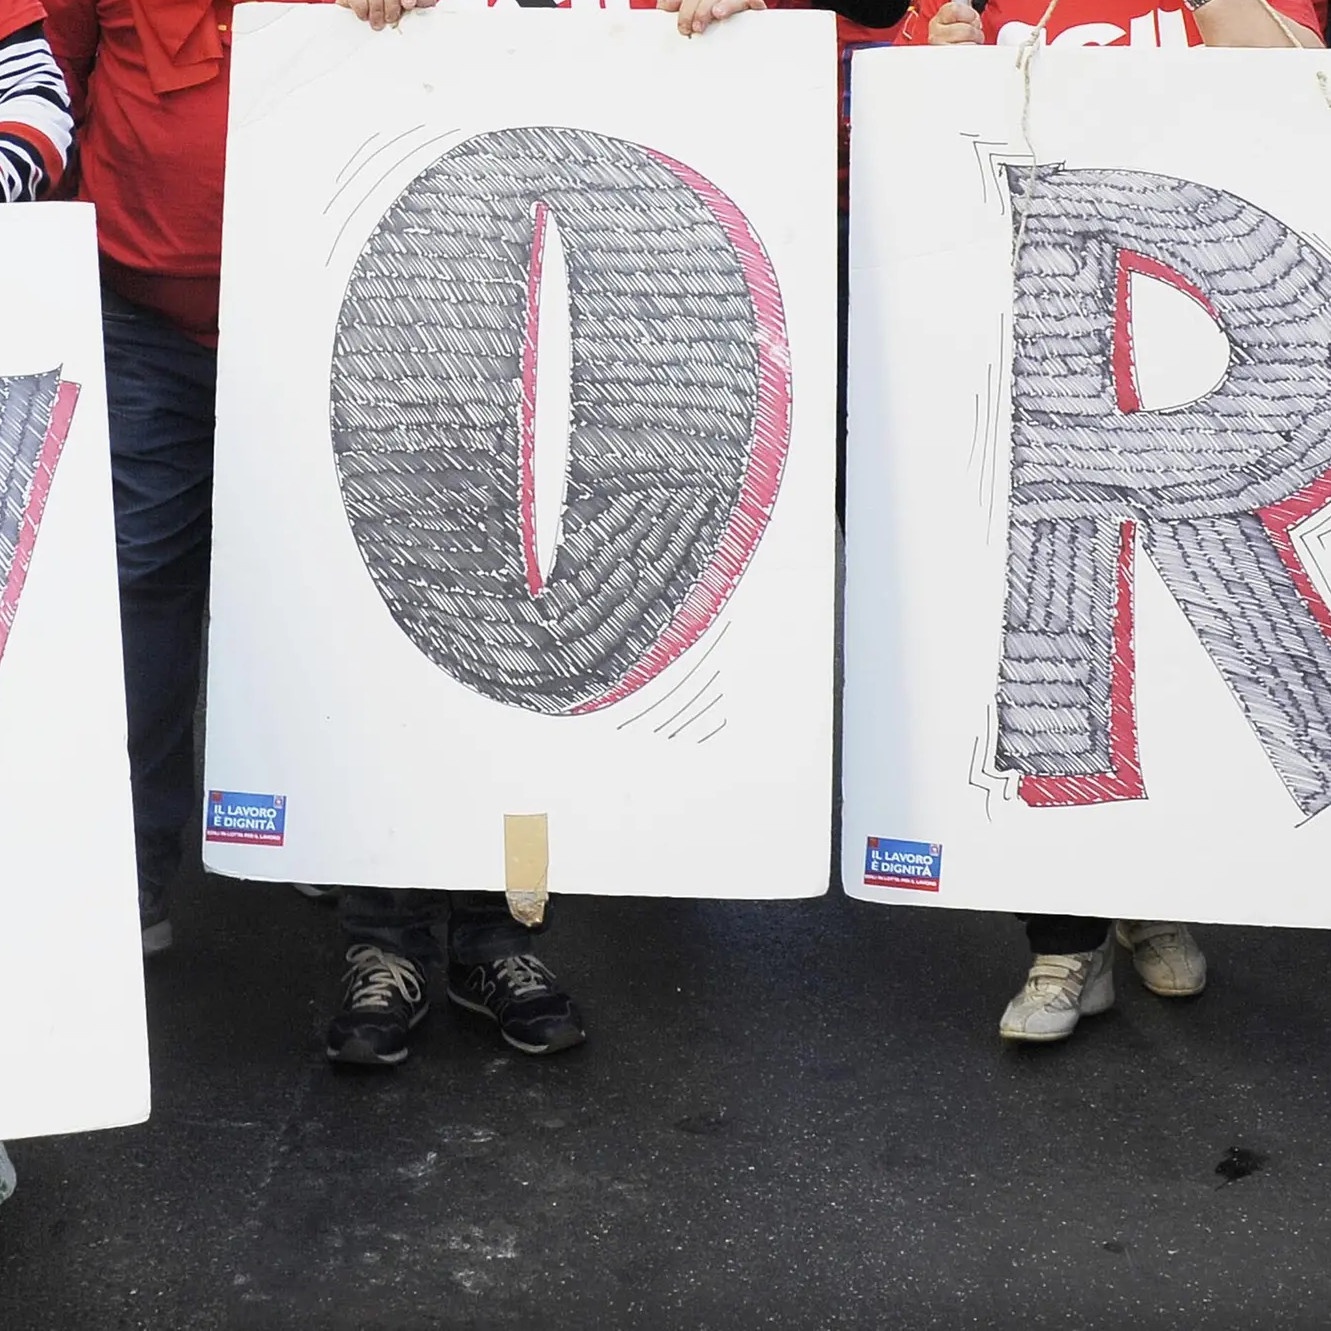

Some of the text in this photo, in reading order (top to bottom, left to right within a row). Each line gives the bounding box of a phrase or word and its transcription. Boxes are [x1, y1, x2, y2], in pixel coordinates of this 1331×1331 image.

[329, 126, 792, 716] O
[996, 160, 1331, 817] R
[214, 805, 277, 819] IL LAVORO
[223, 817, 276, 830] DIGNITÀ
[871, 850, 933, 865] IL LAVORO
[871, 859, 932, 877] È DIGNITÀ
